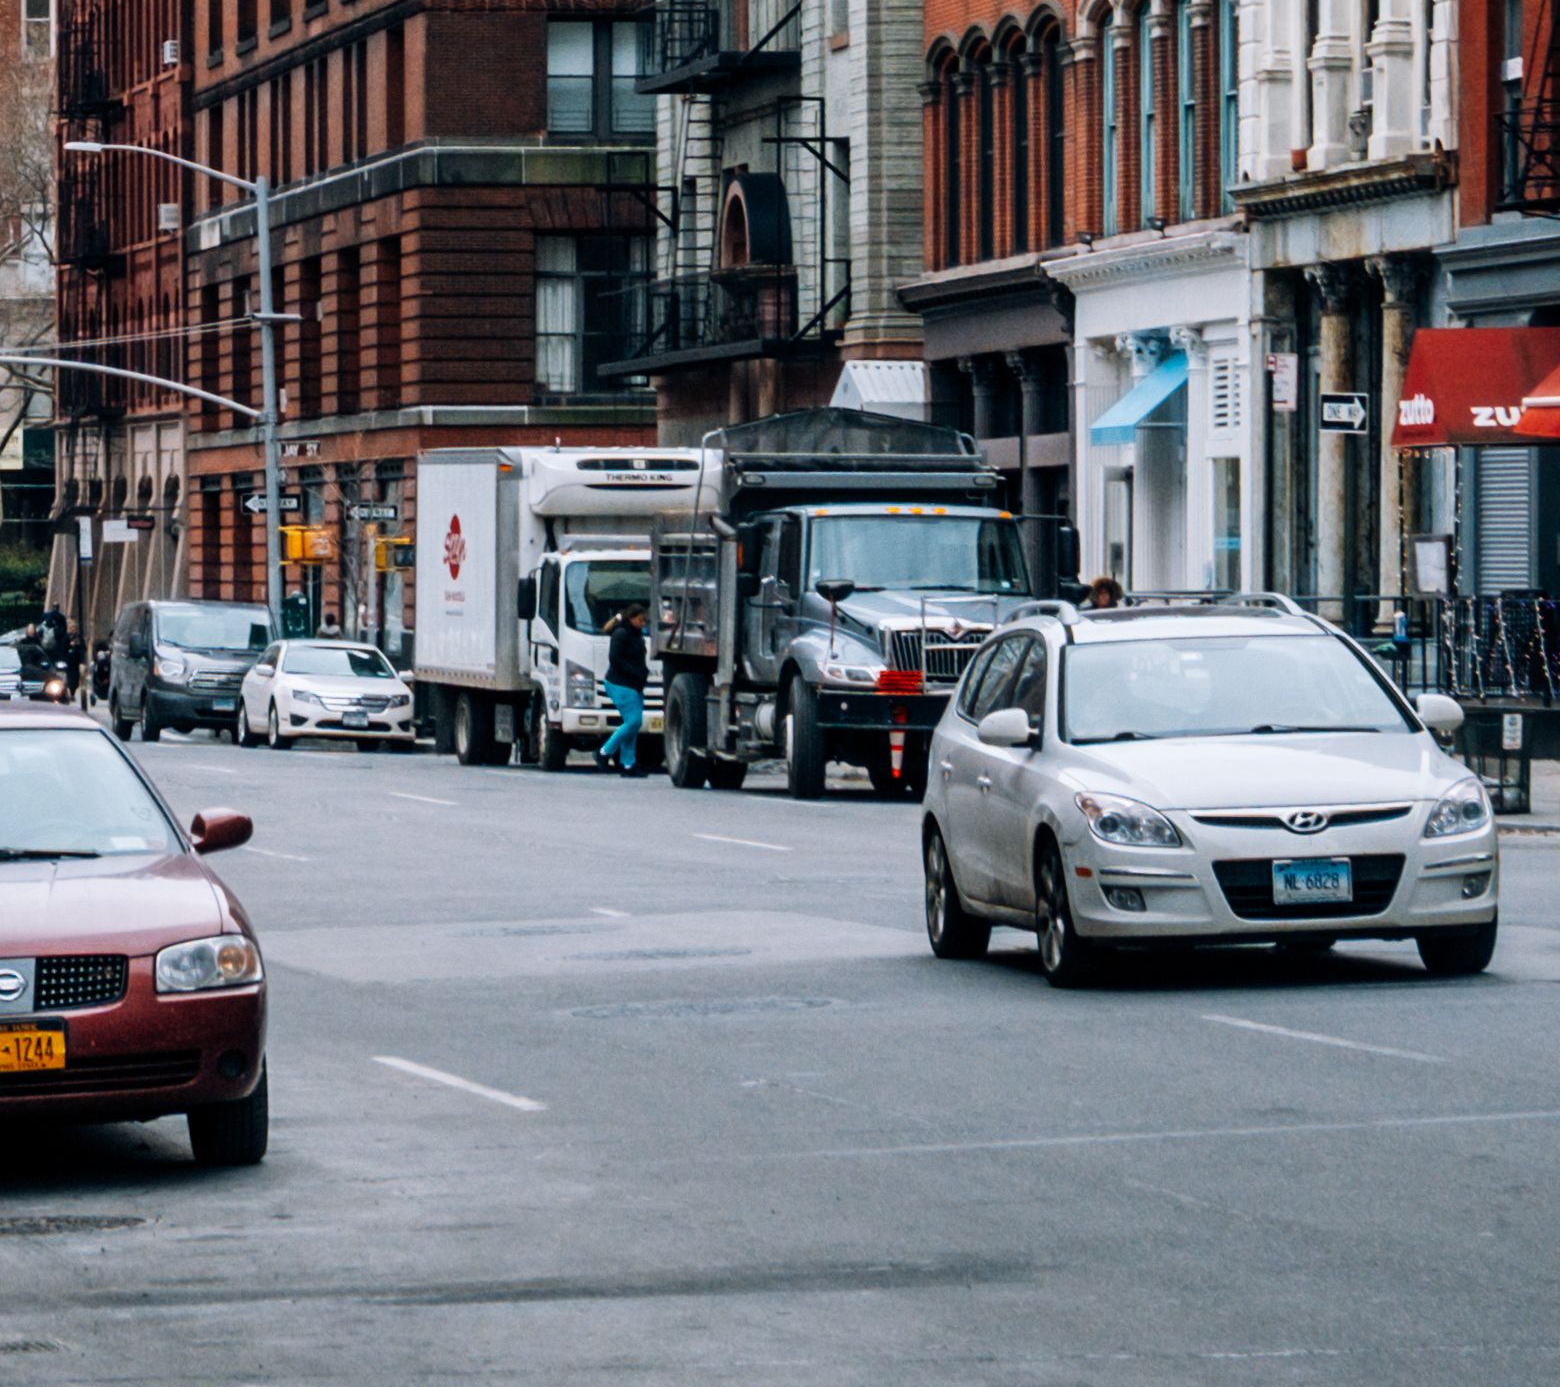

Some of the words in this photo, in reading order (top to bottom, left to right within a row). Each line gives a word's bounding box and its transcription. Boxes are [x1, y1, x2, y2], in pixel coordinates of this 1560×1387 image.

[1326, 405, 1342, 419] ONE
[1399, 393, 1435, 426] zutto
[284, 443, 299, 457] JAY
[605, 473, 647, 482] THERMO
[650, 473, 673, 482] KING
